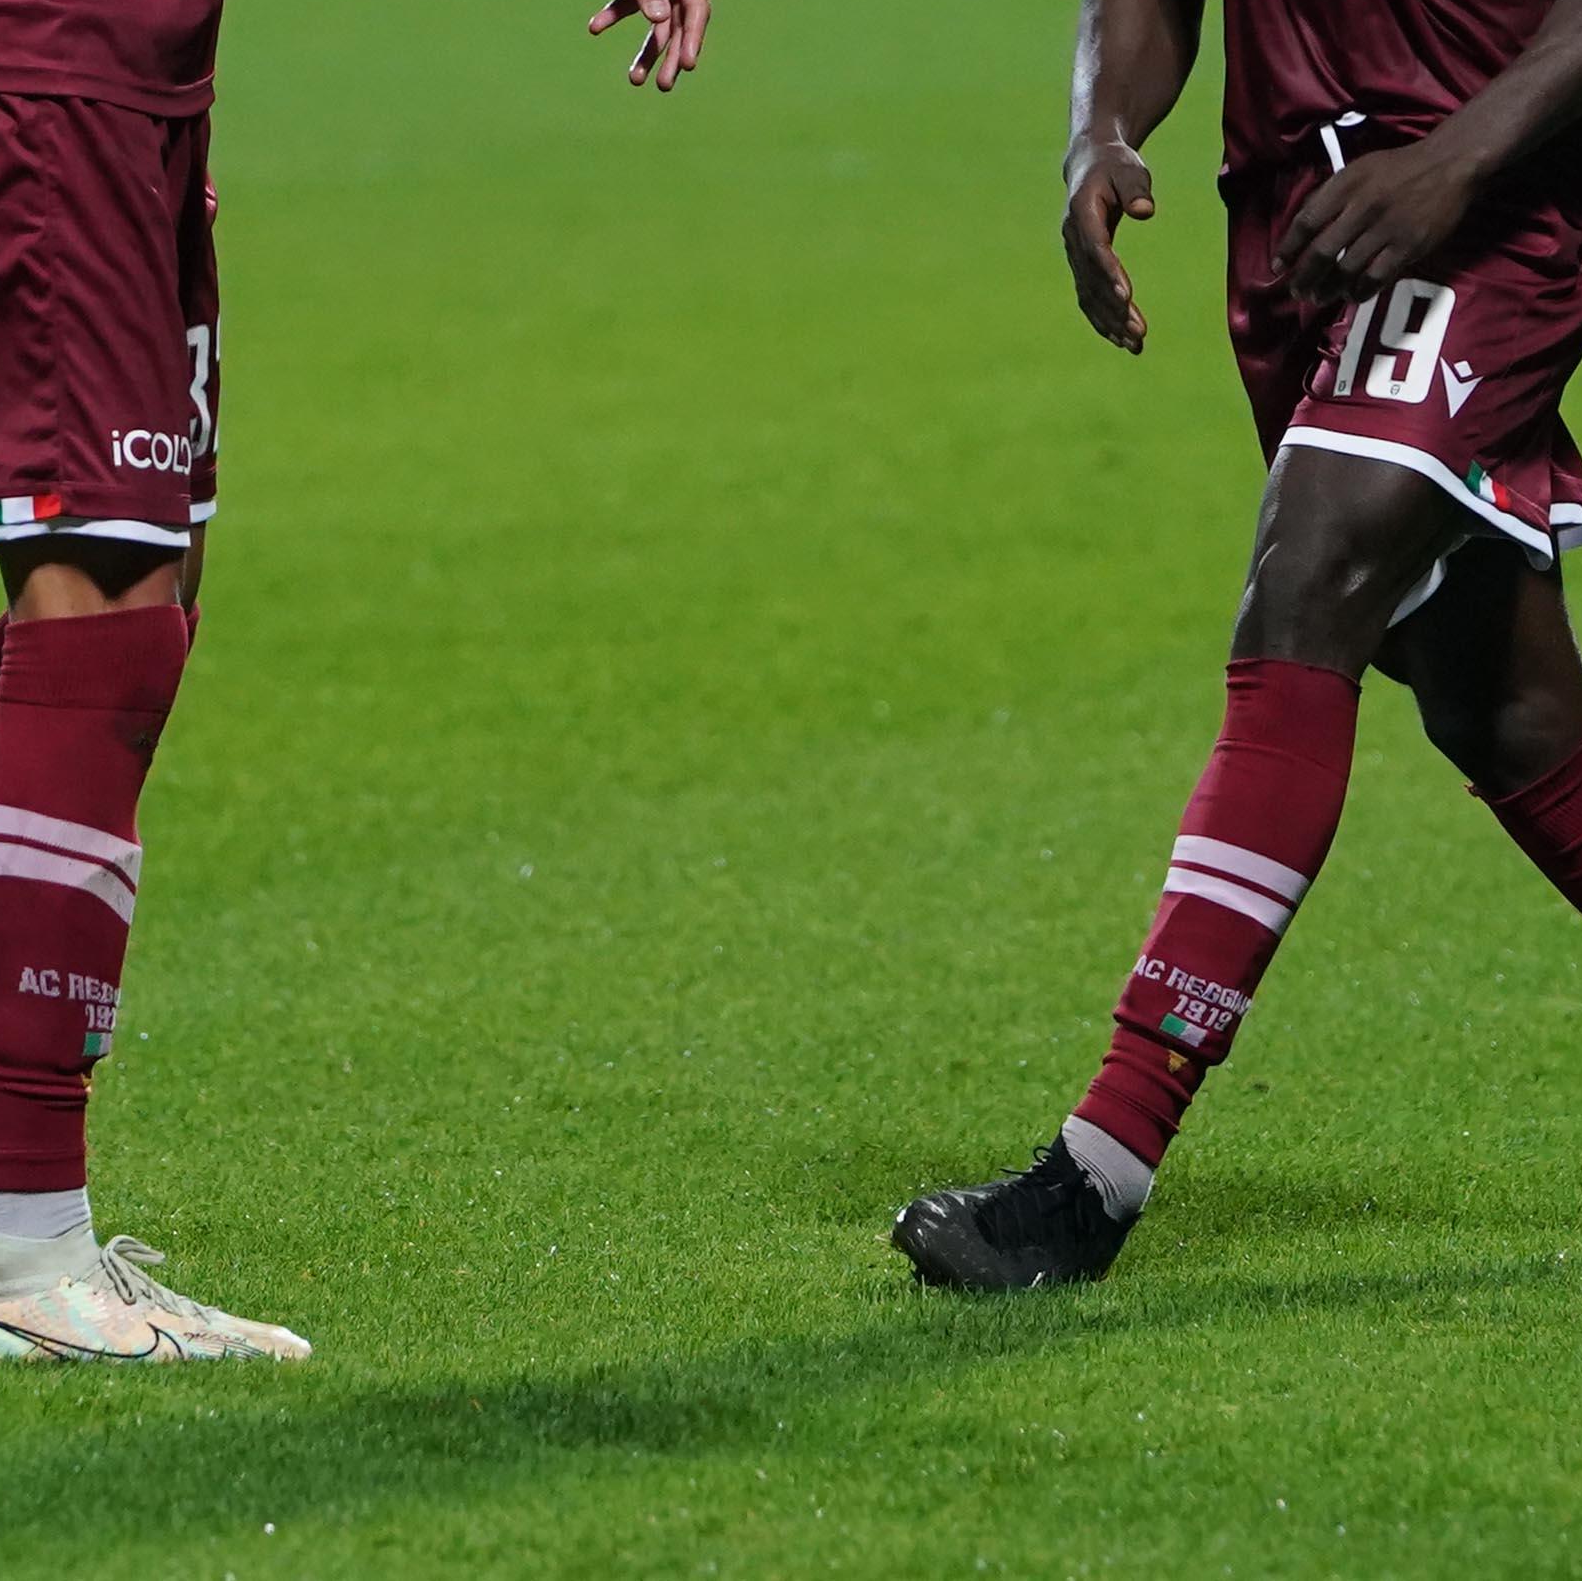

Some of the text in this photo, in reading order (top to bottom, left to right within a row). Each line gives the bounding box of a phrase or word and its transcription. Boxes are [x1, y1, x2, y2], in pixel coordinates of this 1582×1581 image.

[1332, 278, 1457, 404] 19
[18, 965, 61, 998] AC
[1132, 954, 1166, 981] AC
[1172, 993, 1234, 1032] 1919
